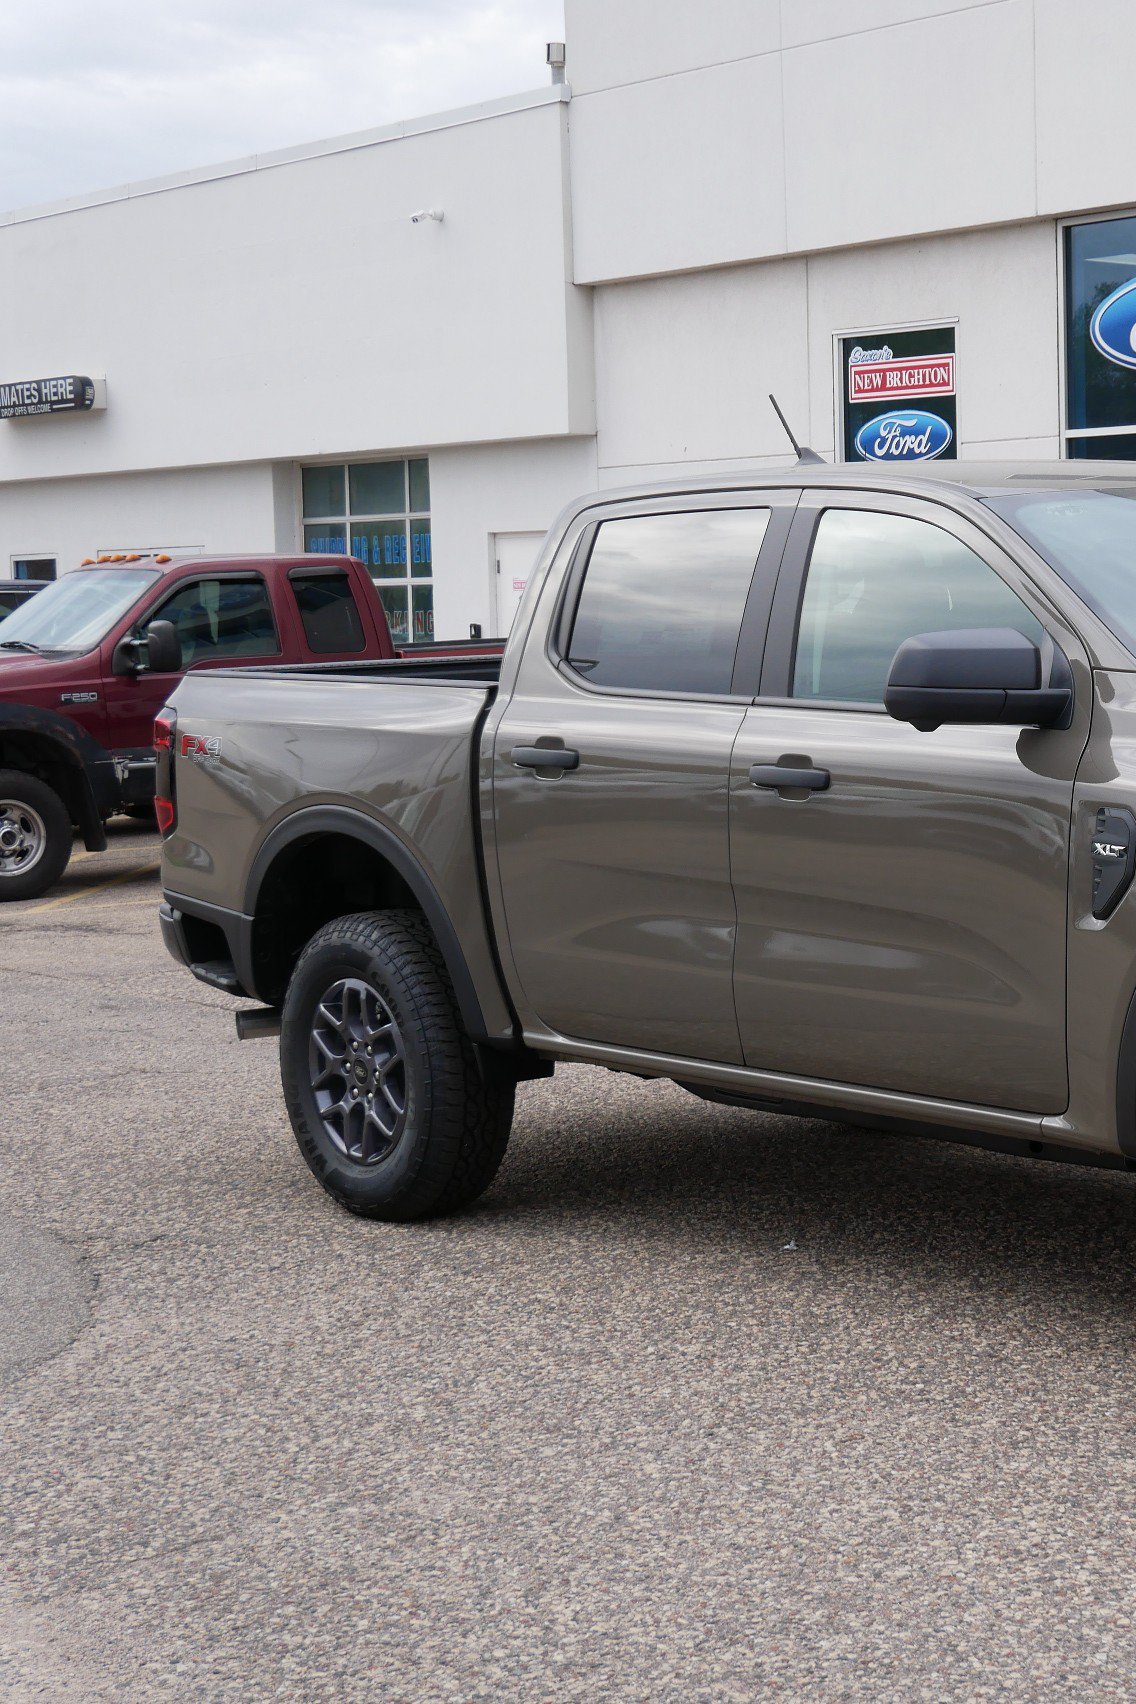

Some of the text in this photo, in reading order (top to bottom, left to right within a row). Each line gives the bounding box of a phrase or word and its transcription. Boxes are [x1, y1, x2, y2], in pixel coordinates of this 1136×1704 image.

[855, 367, 949, 391] NEW BRIGHTON
[0, 382, 39, 407] MATES
[41, 378, 75, 402] HERE
[1, 403, 52, 417] DROP OFFS WELCOME
[874, 418, 933, 457] Ford
[372, 535, 381, 565] &
[181, 733, 223, 758] FX4
[1093, 842, 1126, 857] XLT
